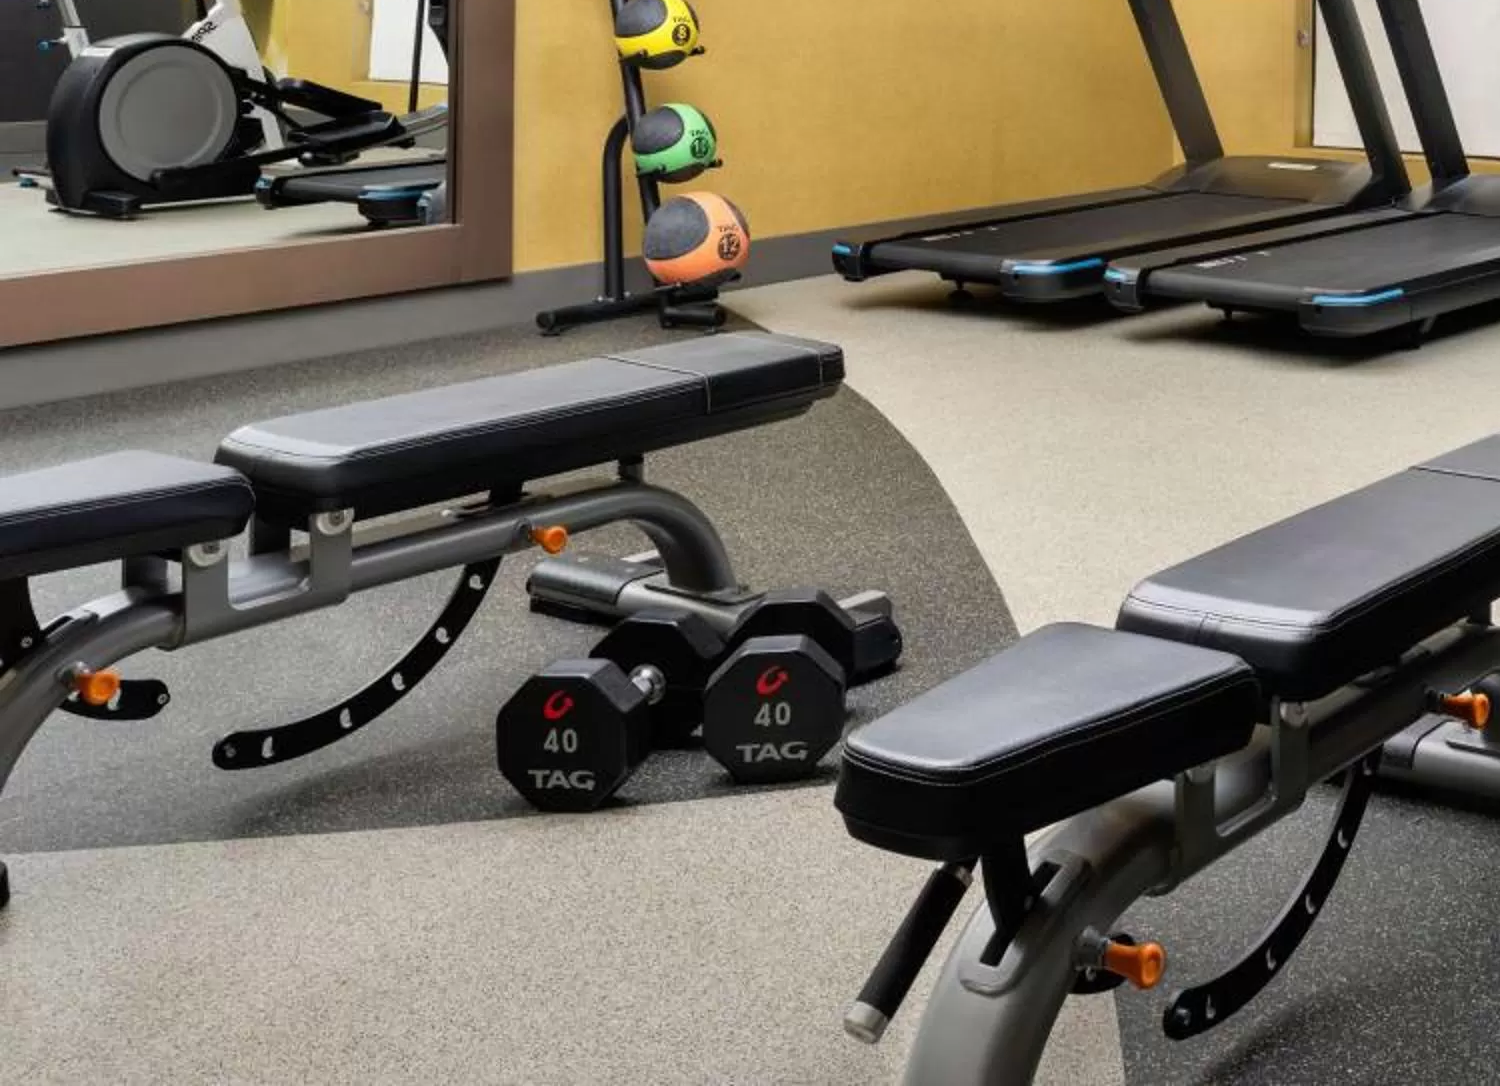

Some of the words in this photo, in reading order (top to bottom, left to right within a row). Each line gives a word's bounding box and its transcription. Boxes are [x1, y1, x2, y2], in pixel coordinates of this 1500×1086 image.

[722, 236, 738, 253] 12
[754, 701, 791, 727] 40
[543, 727, 578, 753] 40
[735, 741, 808, 763] TAG
[527, 769, 596, 791] TAG
